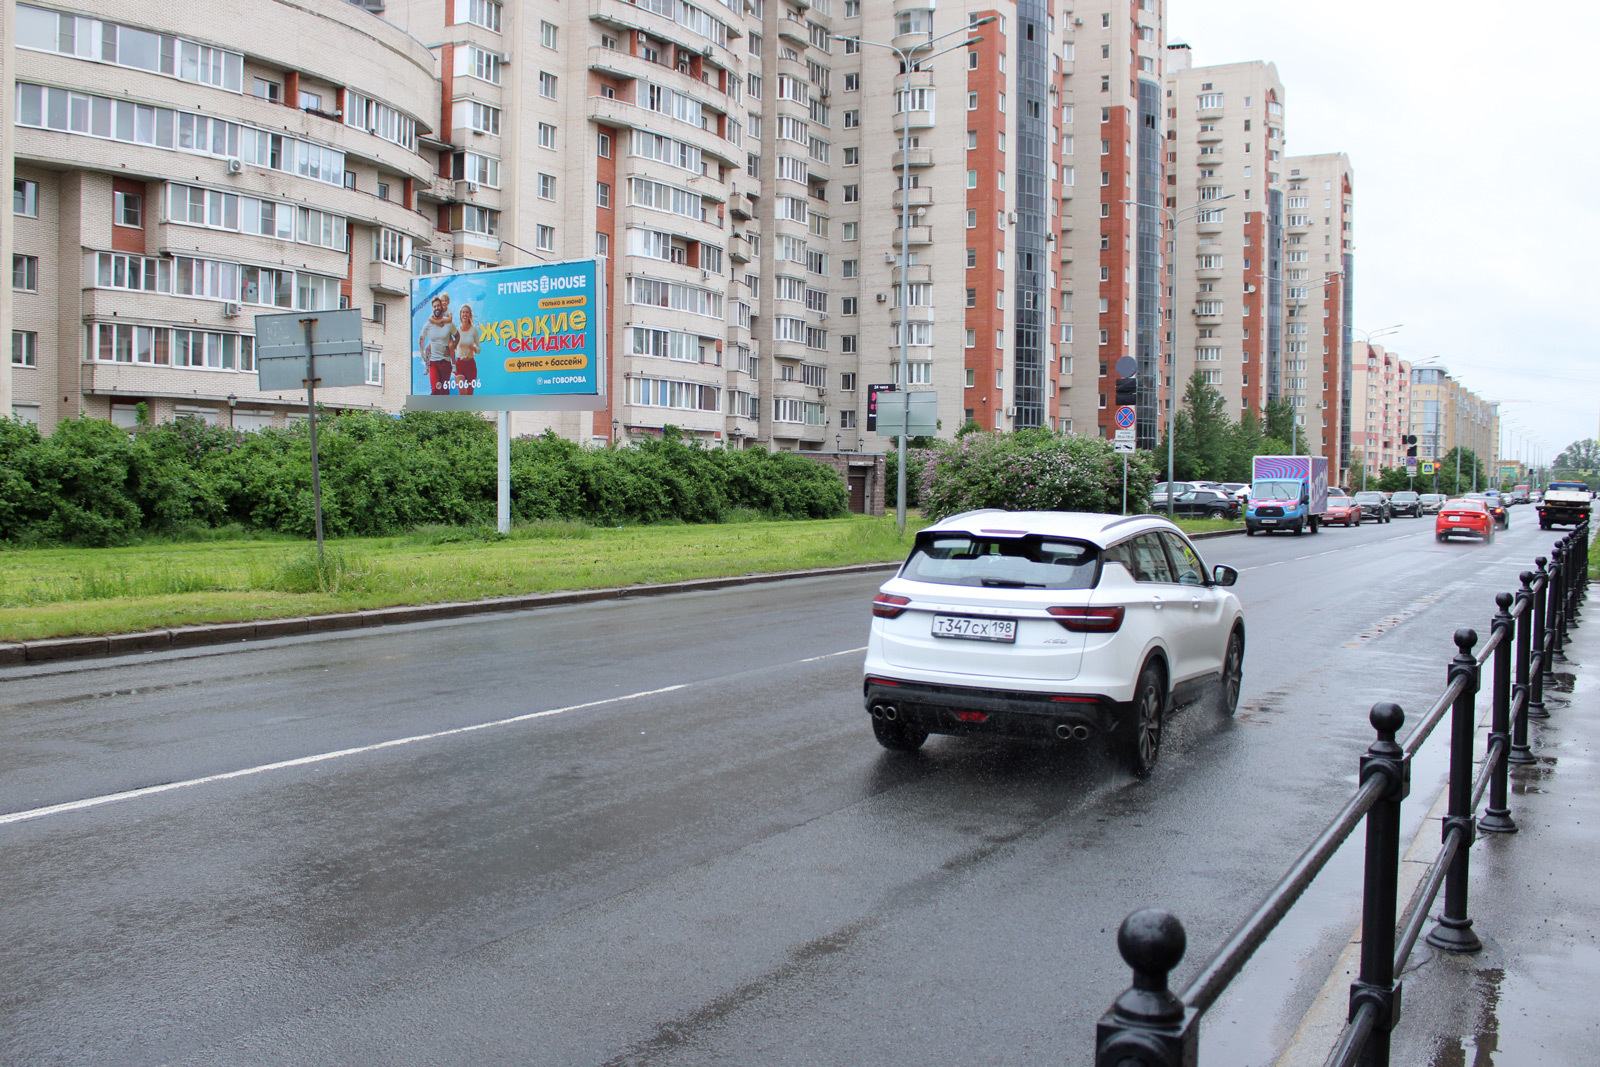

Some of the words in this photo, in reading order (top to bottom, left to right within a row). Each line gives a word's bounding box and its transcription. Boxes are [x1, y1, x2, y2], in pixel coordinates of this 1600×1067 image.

[498, 280, 539, 294] FITNESS
[550, 275, 586, 290] HOUSE
[478, 310, 587, 346] жаркие
[517, 360, 543, 370] фитнес
[551, 357, 582, 367] бассейн
[443, 379, 482, 390] 610-06-06
[552, 376, 587, 384] ГОВОРОВА
[991, 621, 1012, 633] 198
